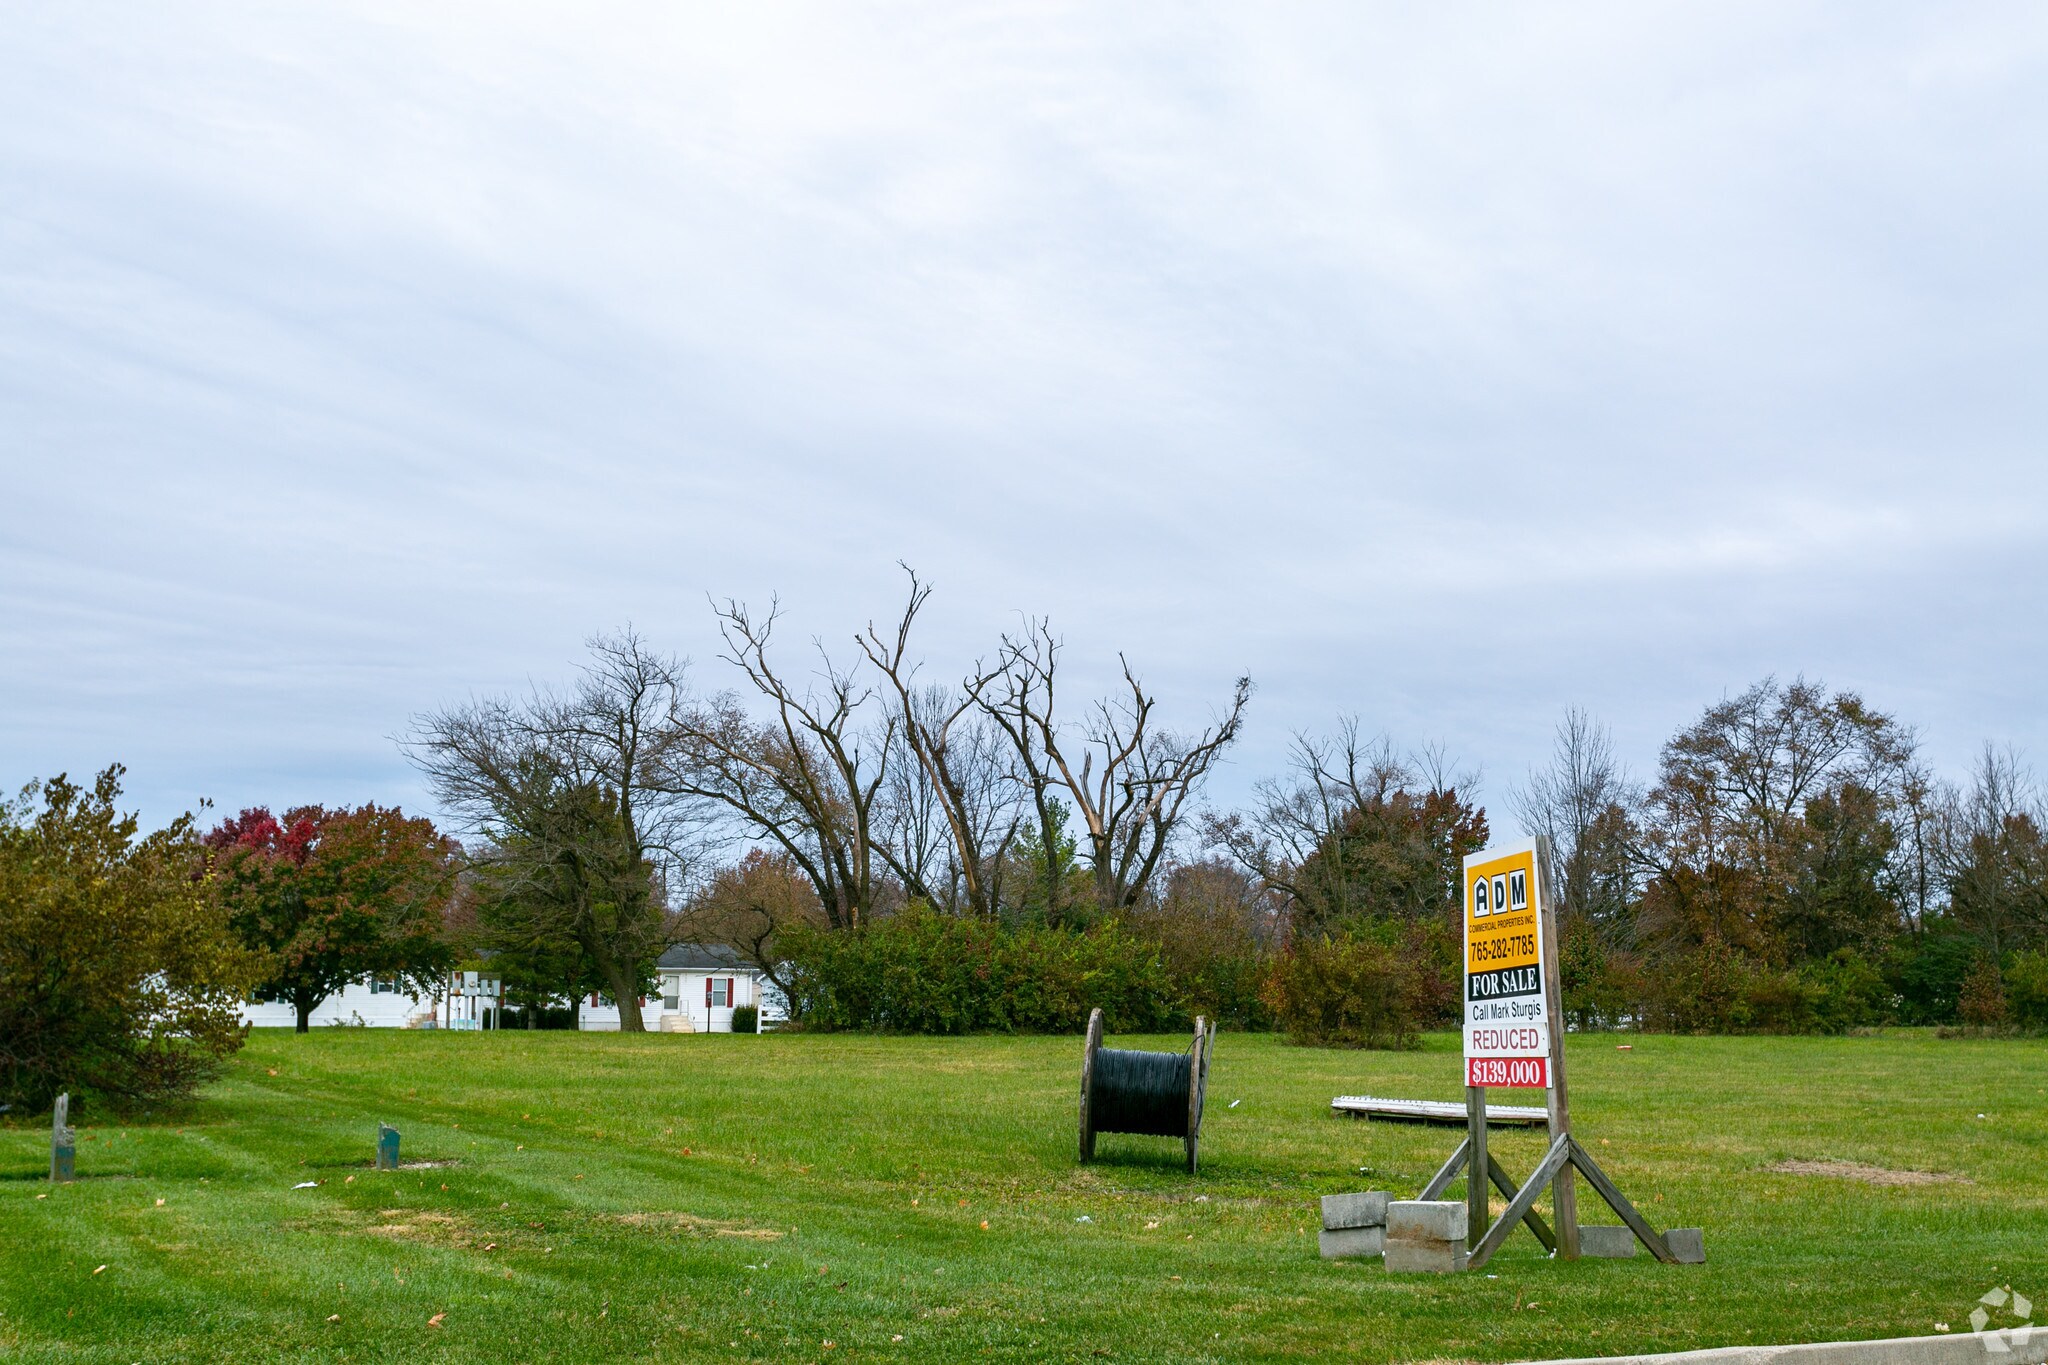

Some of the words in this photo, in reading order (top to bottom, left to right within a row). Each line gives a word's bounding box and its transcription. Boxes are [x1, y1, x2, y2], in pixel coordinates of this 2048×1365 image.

[1476, 874, 1525, 911] ADM
[1469, 921, 1497, 933] COMMERCIAL
[1498, 916, 1524, 929] PROPERTIES
[1525, 915, 1535, 925] INC.
[1471, 934, 1534, 962] 765-282-7785
[1472, 973, 1500, 997] FOR
[1502, 967, 1537, 993] SALE
[1472, 1003, 1489, 1021] Call
[1491, 1002, 1510, 1020] Mark
[1511, 999, 1541, 1021] Sturgis
[1472, 1028, 1539, 1050] REDUCED
[1472, 1059, 1540, 1087] $139,000
